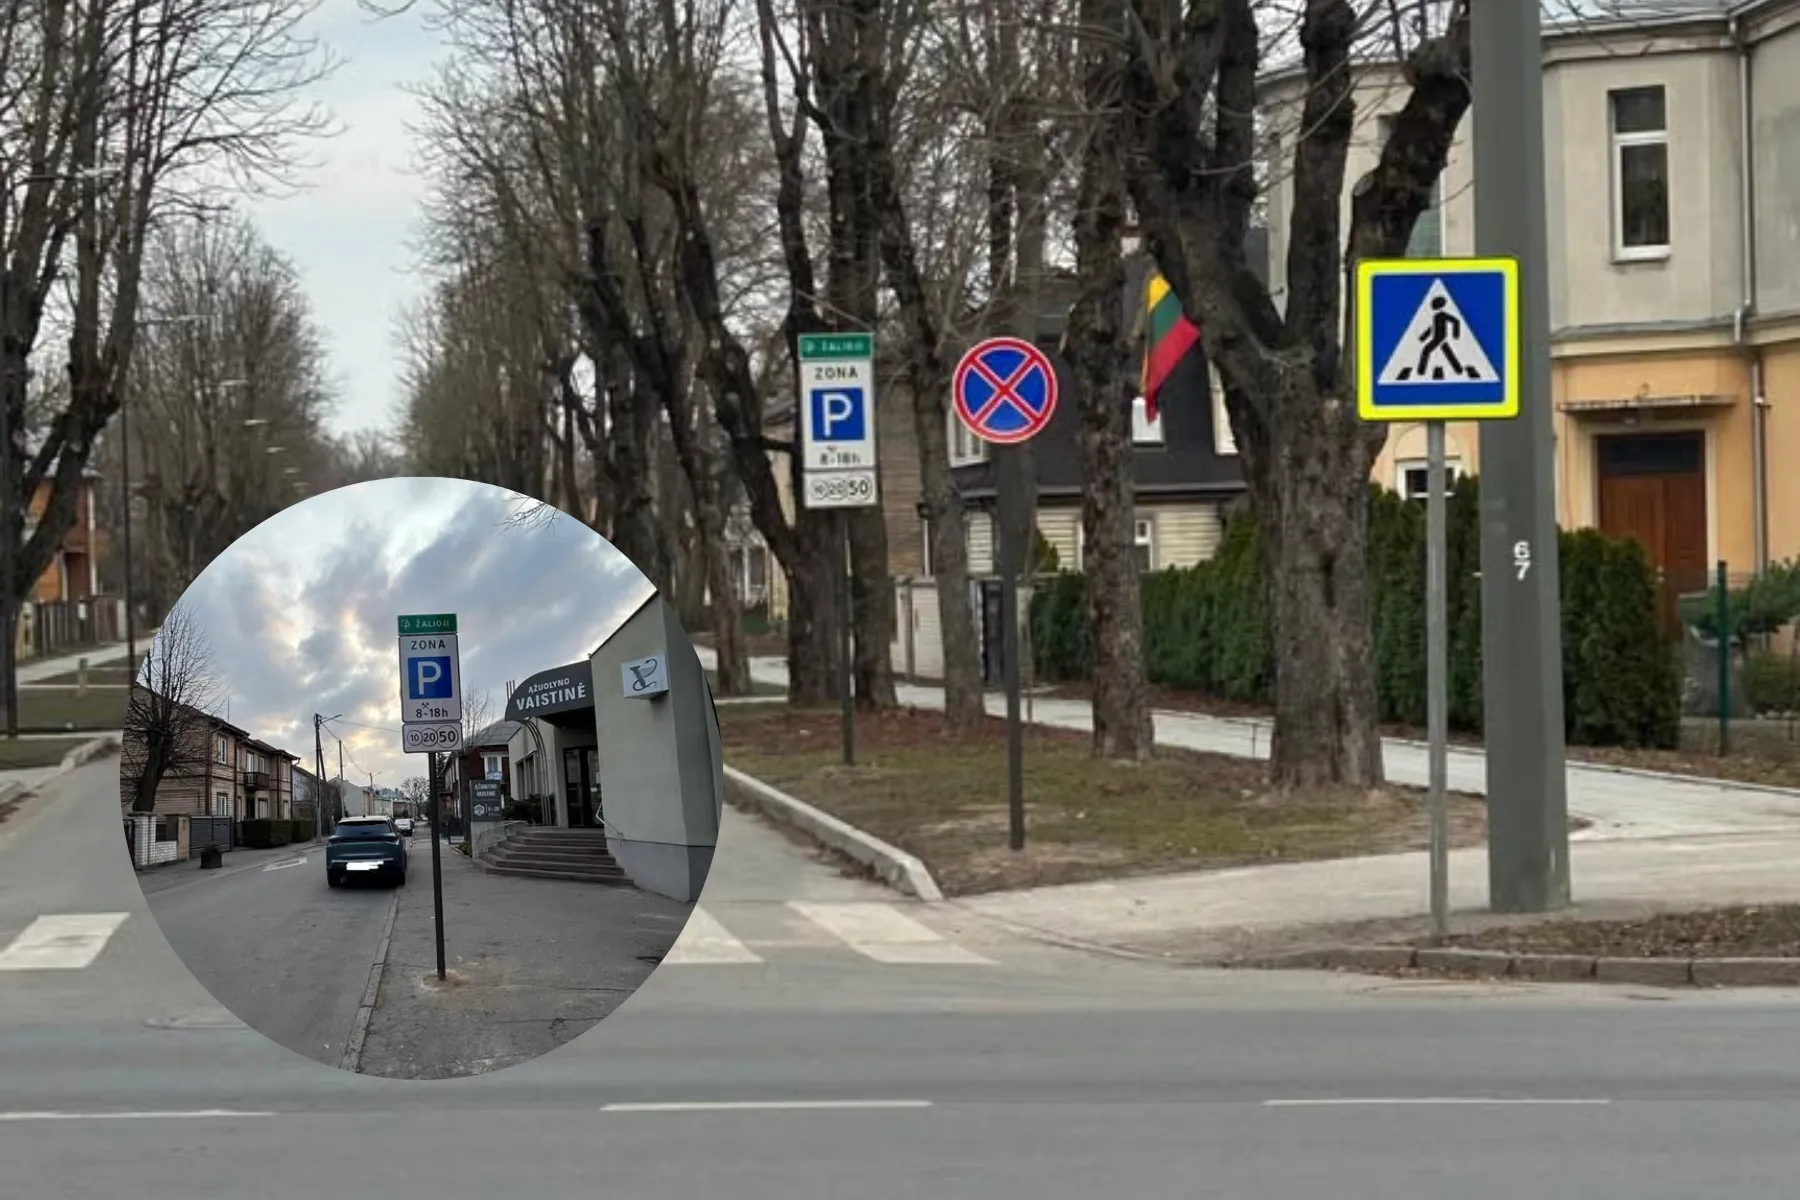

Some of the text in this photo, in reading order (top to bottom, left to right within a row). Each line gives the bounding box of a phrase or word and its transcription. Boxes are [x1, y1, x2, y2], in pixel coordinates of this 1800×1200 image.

[814, 366, 858, 380] ZONA
[822, 393, 853, 437] P
[848, 479, 868, 496] 50
[411, 640, 446, 650] ZONA
[417, 661, 442, 695] P
[528, 677, 570, 694] ĄŽUOLYNO
[516, 682, 586, 710] VAISTINĖ
[410, 730, 456, 743] 10 20 50
